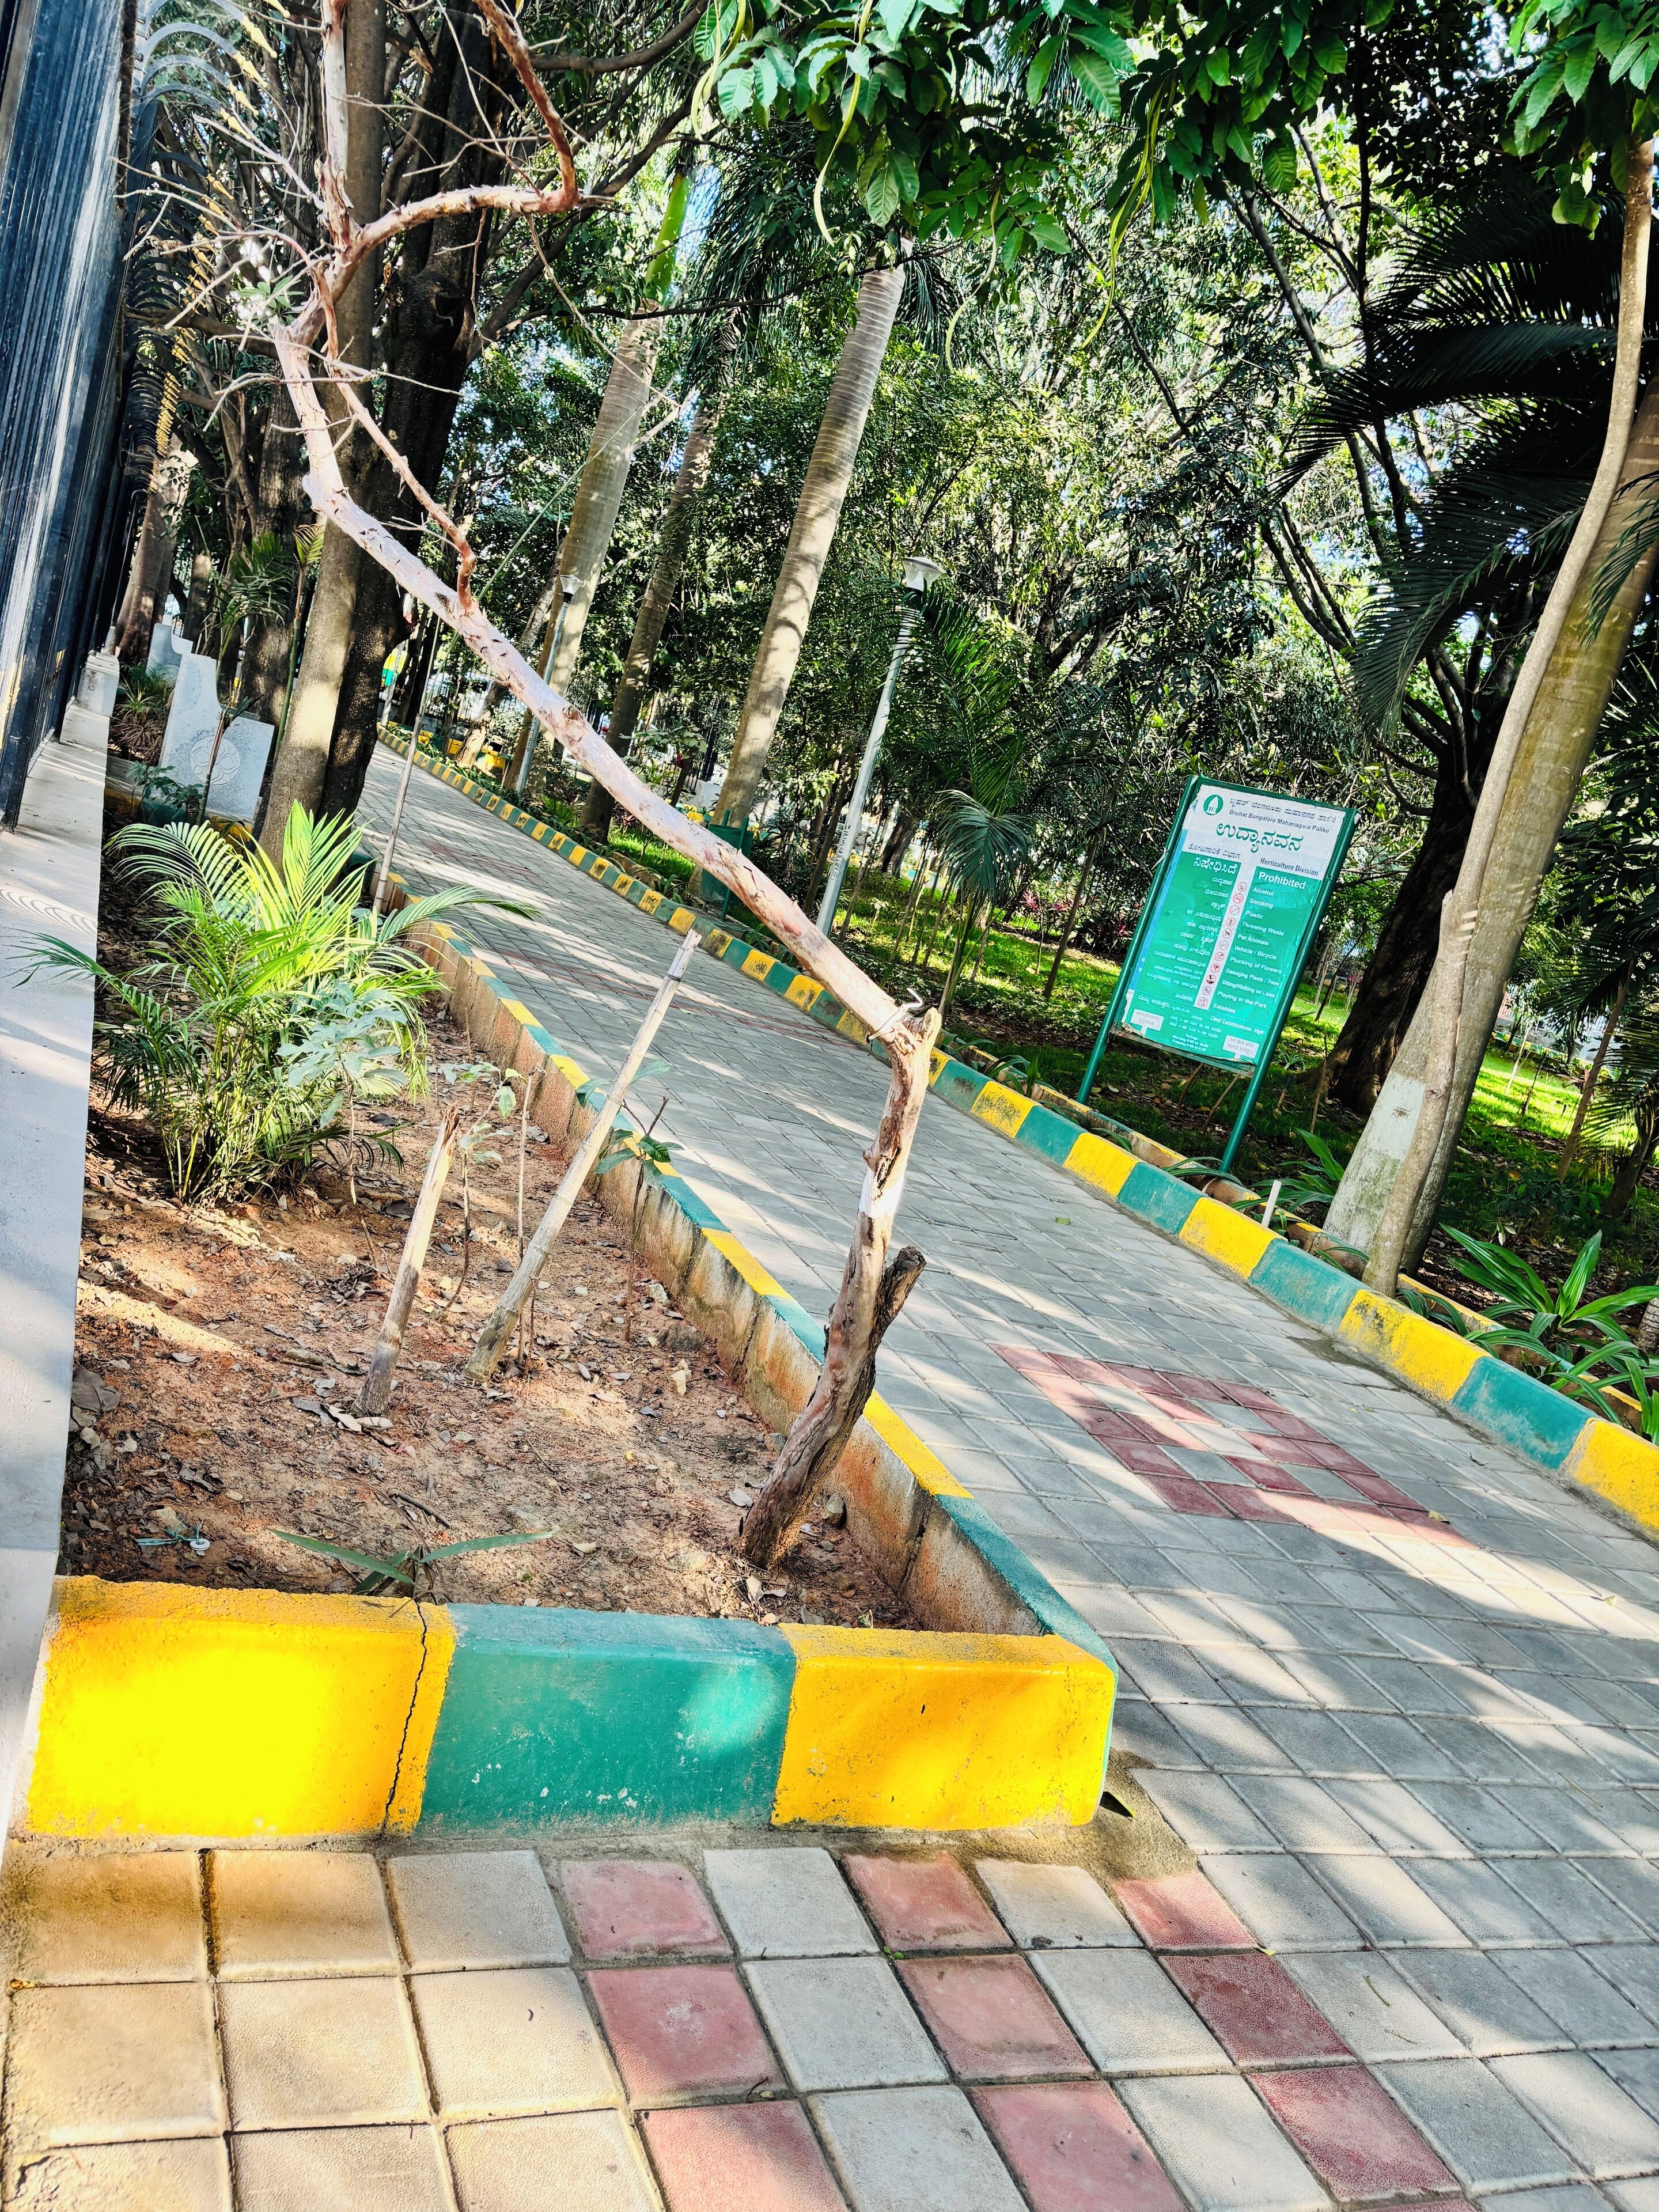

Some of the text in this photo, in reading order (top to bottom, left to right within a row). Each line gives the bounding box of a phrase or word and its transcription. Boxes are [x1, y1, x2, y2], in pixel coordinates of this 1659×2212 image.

[1229, 810, 1330, 834] Bruhat Bangalore Mahanagara Palike
[1216, 823, 1304, 853] ಉದ್ಯಾನವನ
[1193, 857, 1238, 874] ನಿಷೇಧಿಸಿದೆ
[1260, 858, 1319, 876] Horticulture Division
[1258, 871, 1306, 889] Prohibited
[1252, 887, 1274, 896] Alcohol
[1249, 897, 1274, 909] Smoking
[1245, 910, 1264, 919] Plastic
[1241, 922, 1285, 936] Throwing Waste
[1248, 937, 1269, 946] Animals
[1234, 945, 1253, 955] Vehicle
[1257, 950, 1277, 960] Bicycle
[1230, 957, 1253, 968] Plucking
[1261, 964, 1282, 974] Flowers
[1226, 968, 1248, 979] Damaging
[1249, 974, 1264, 982] Plants
[1267, 978, 1279, 987] Trees
[1213, 1003, 1236, 1014] Eatables
[1217, 991, 1237, 1002] Playing
[1254, 1001, 1267, 1009] Park
